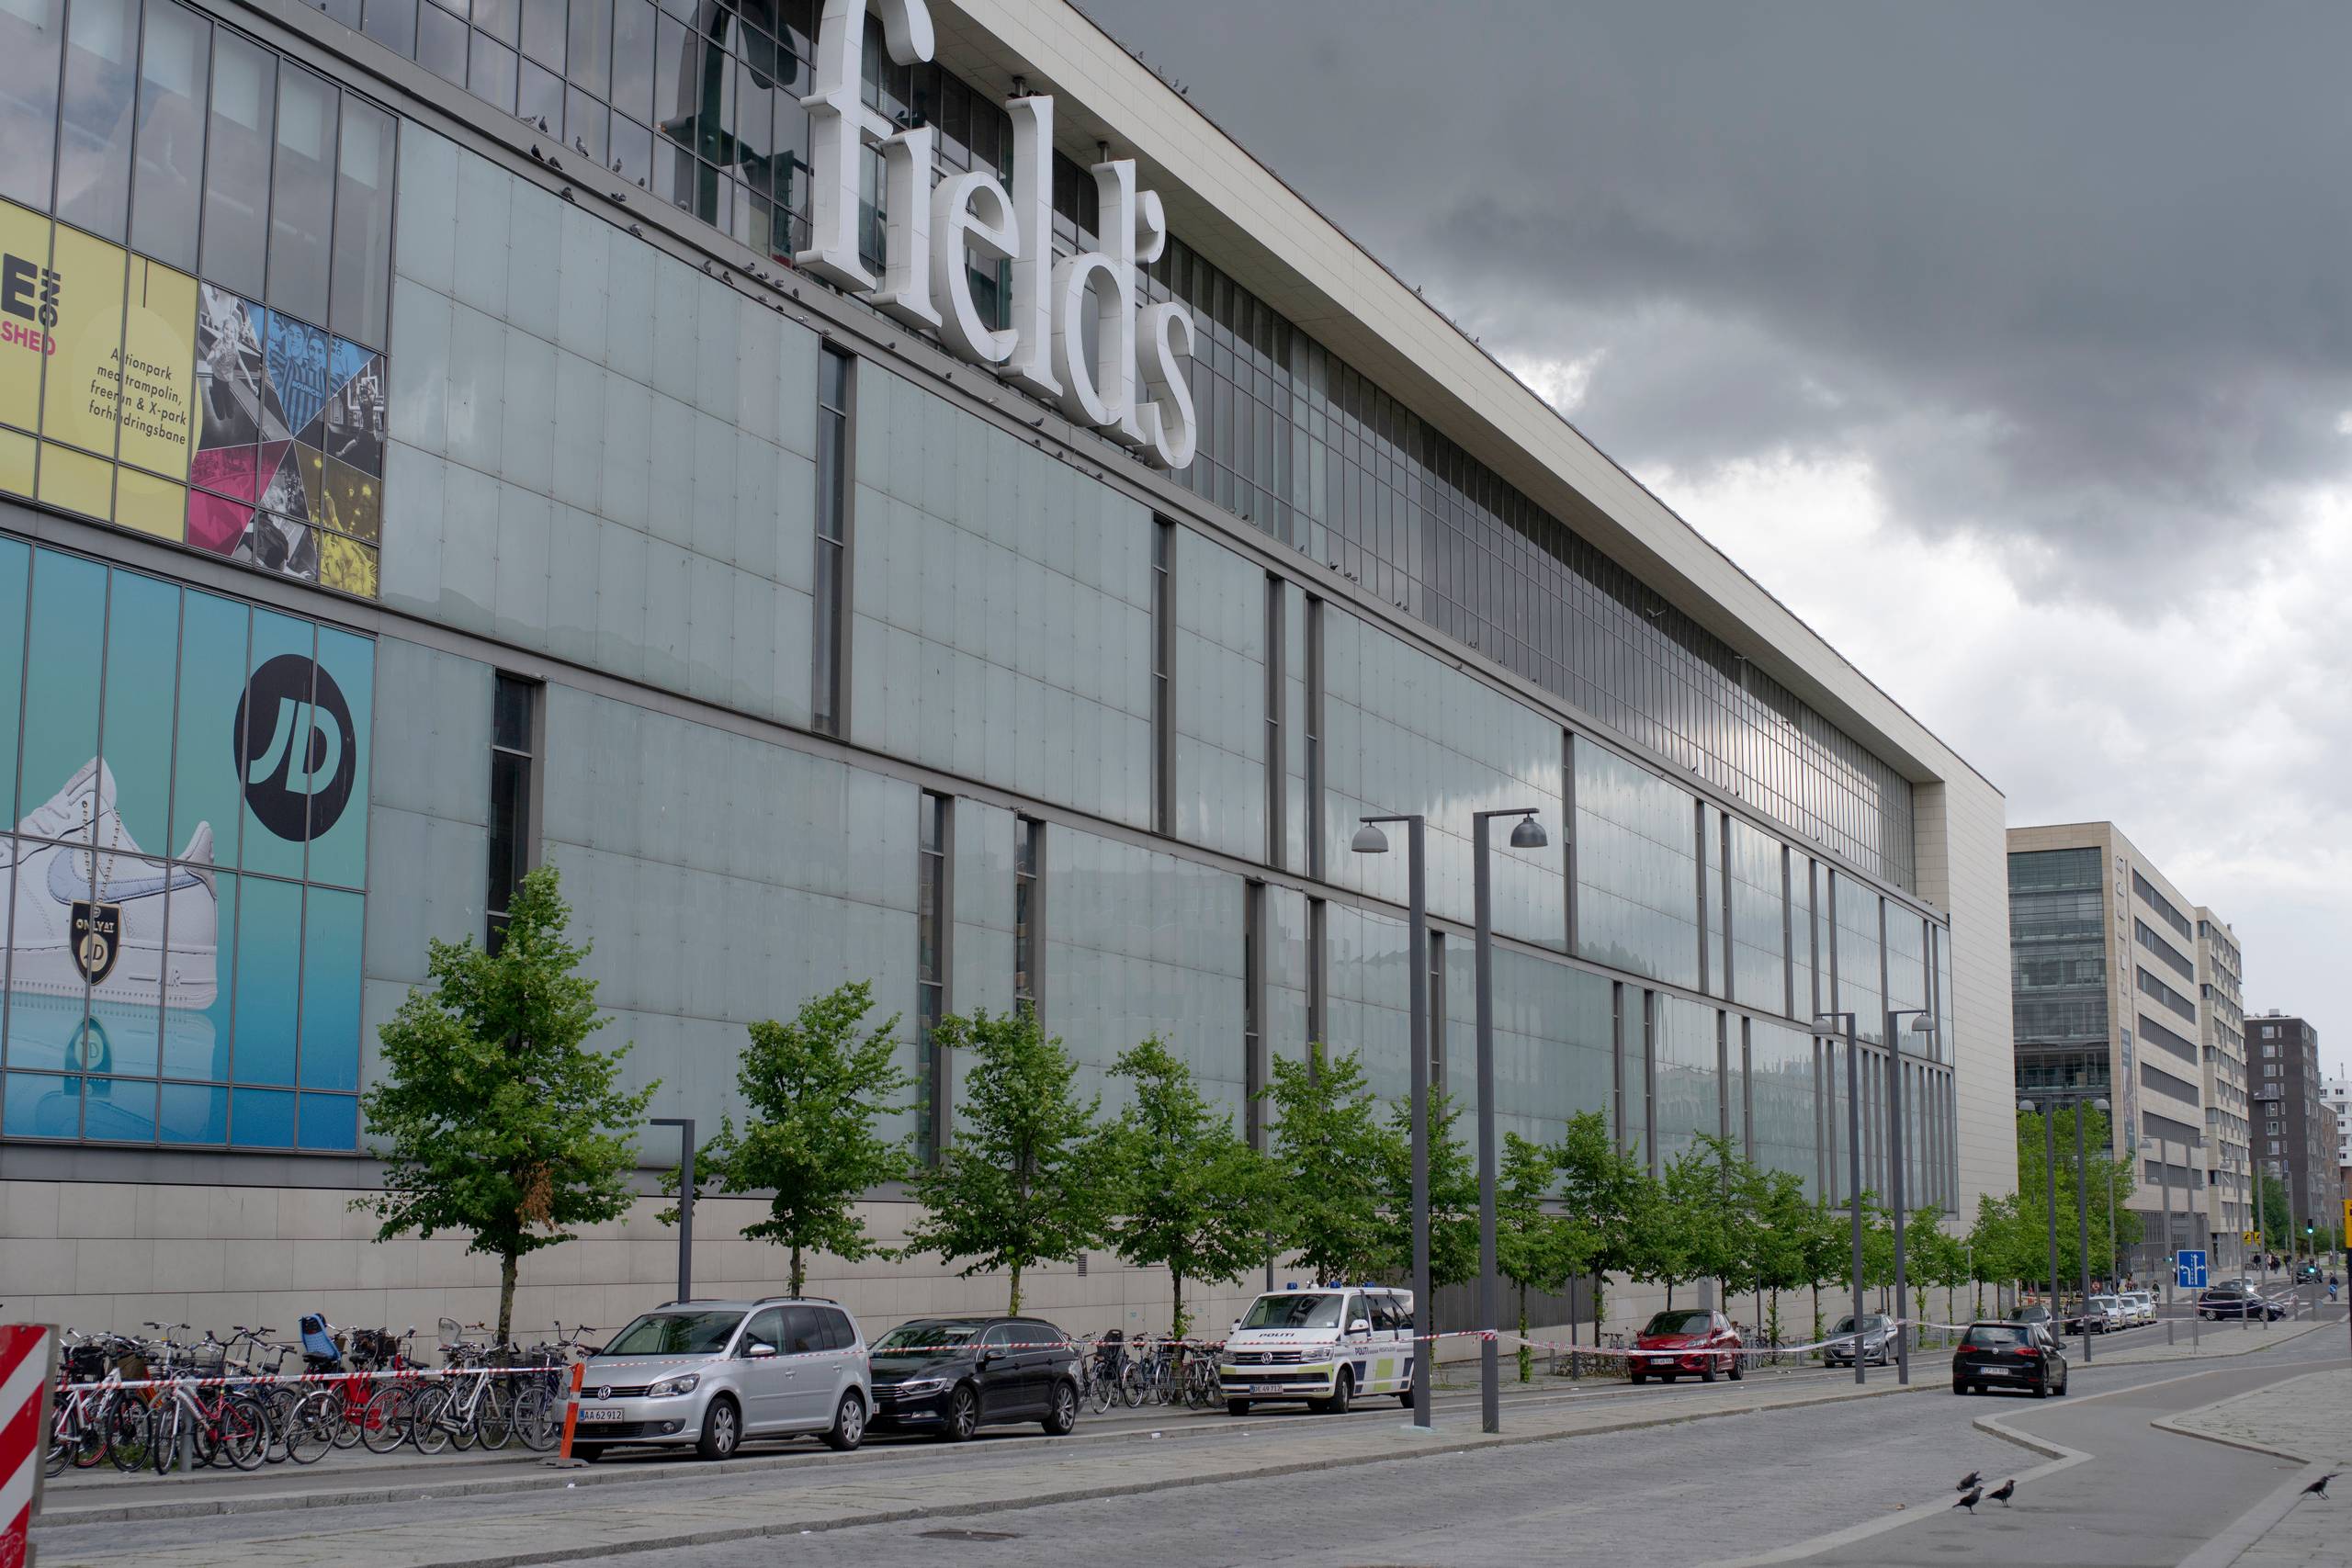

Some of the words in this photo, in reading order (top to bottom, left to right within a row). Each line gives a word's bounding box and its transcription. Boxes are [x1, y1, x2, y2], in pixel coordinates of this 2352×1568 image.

[0, 320, 57, 355] SHED
[110, 347, 173, 380] Ationpark
[125, 374, 182, 406] trampolin,
[136, 397, 144, 412] &
[148, 401, 187, 426] X-park
[248, 696, 342, 795] JD
[584, 1410, 594, 1420] AA
[595, 1410, 605, 1420] 62
[606, 1410, 622, 1420] 912
